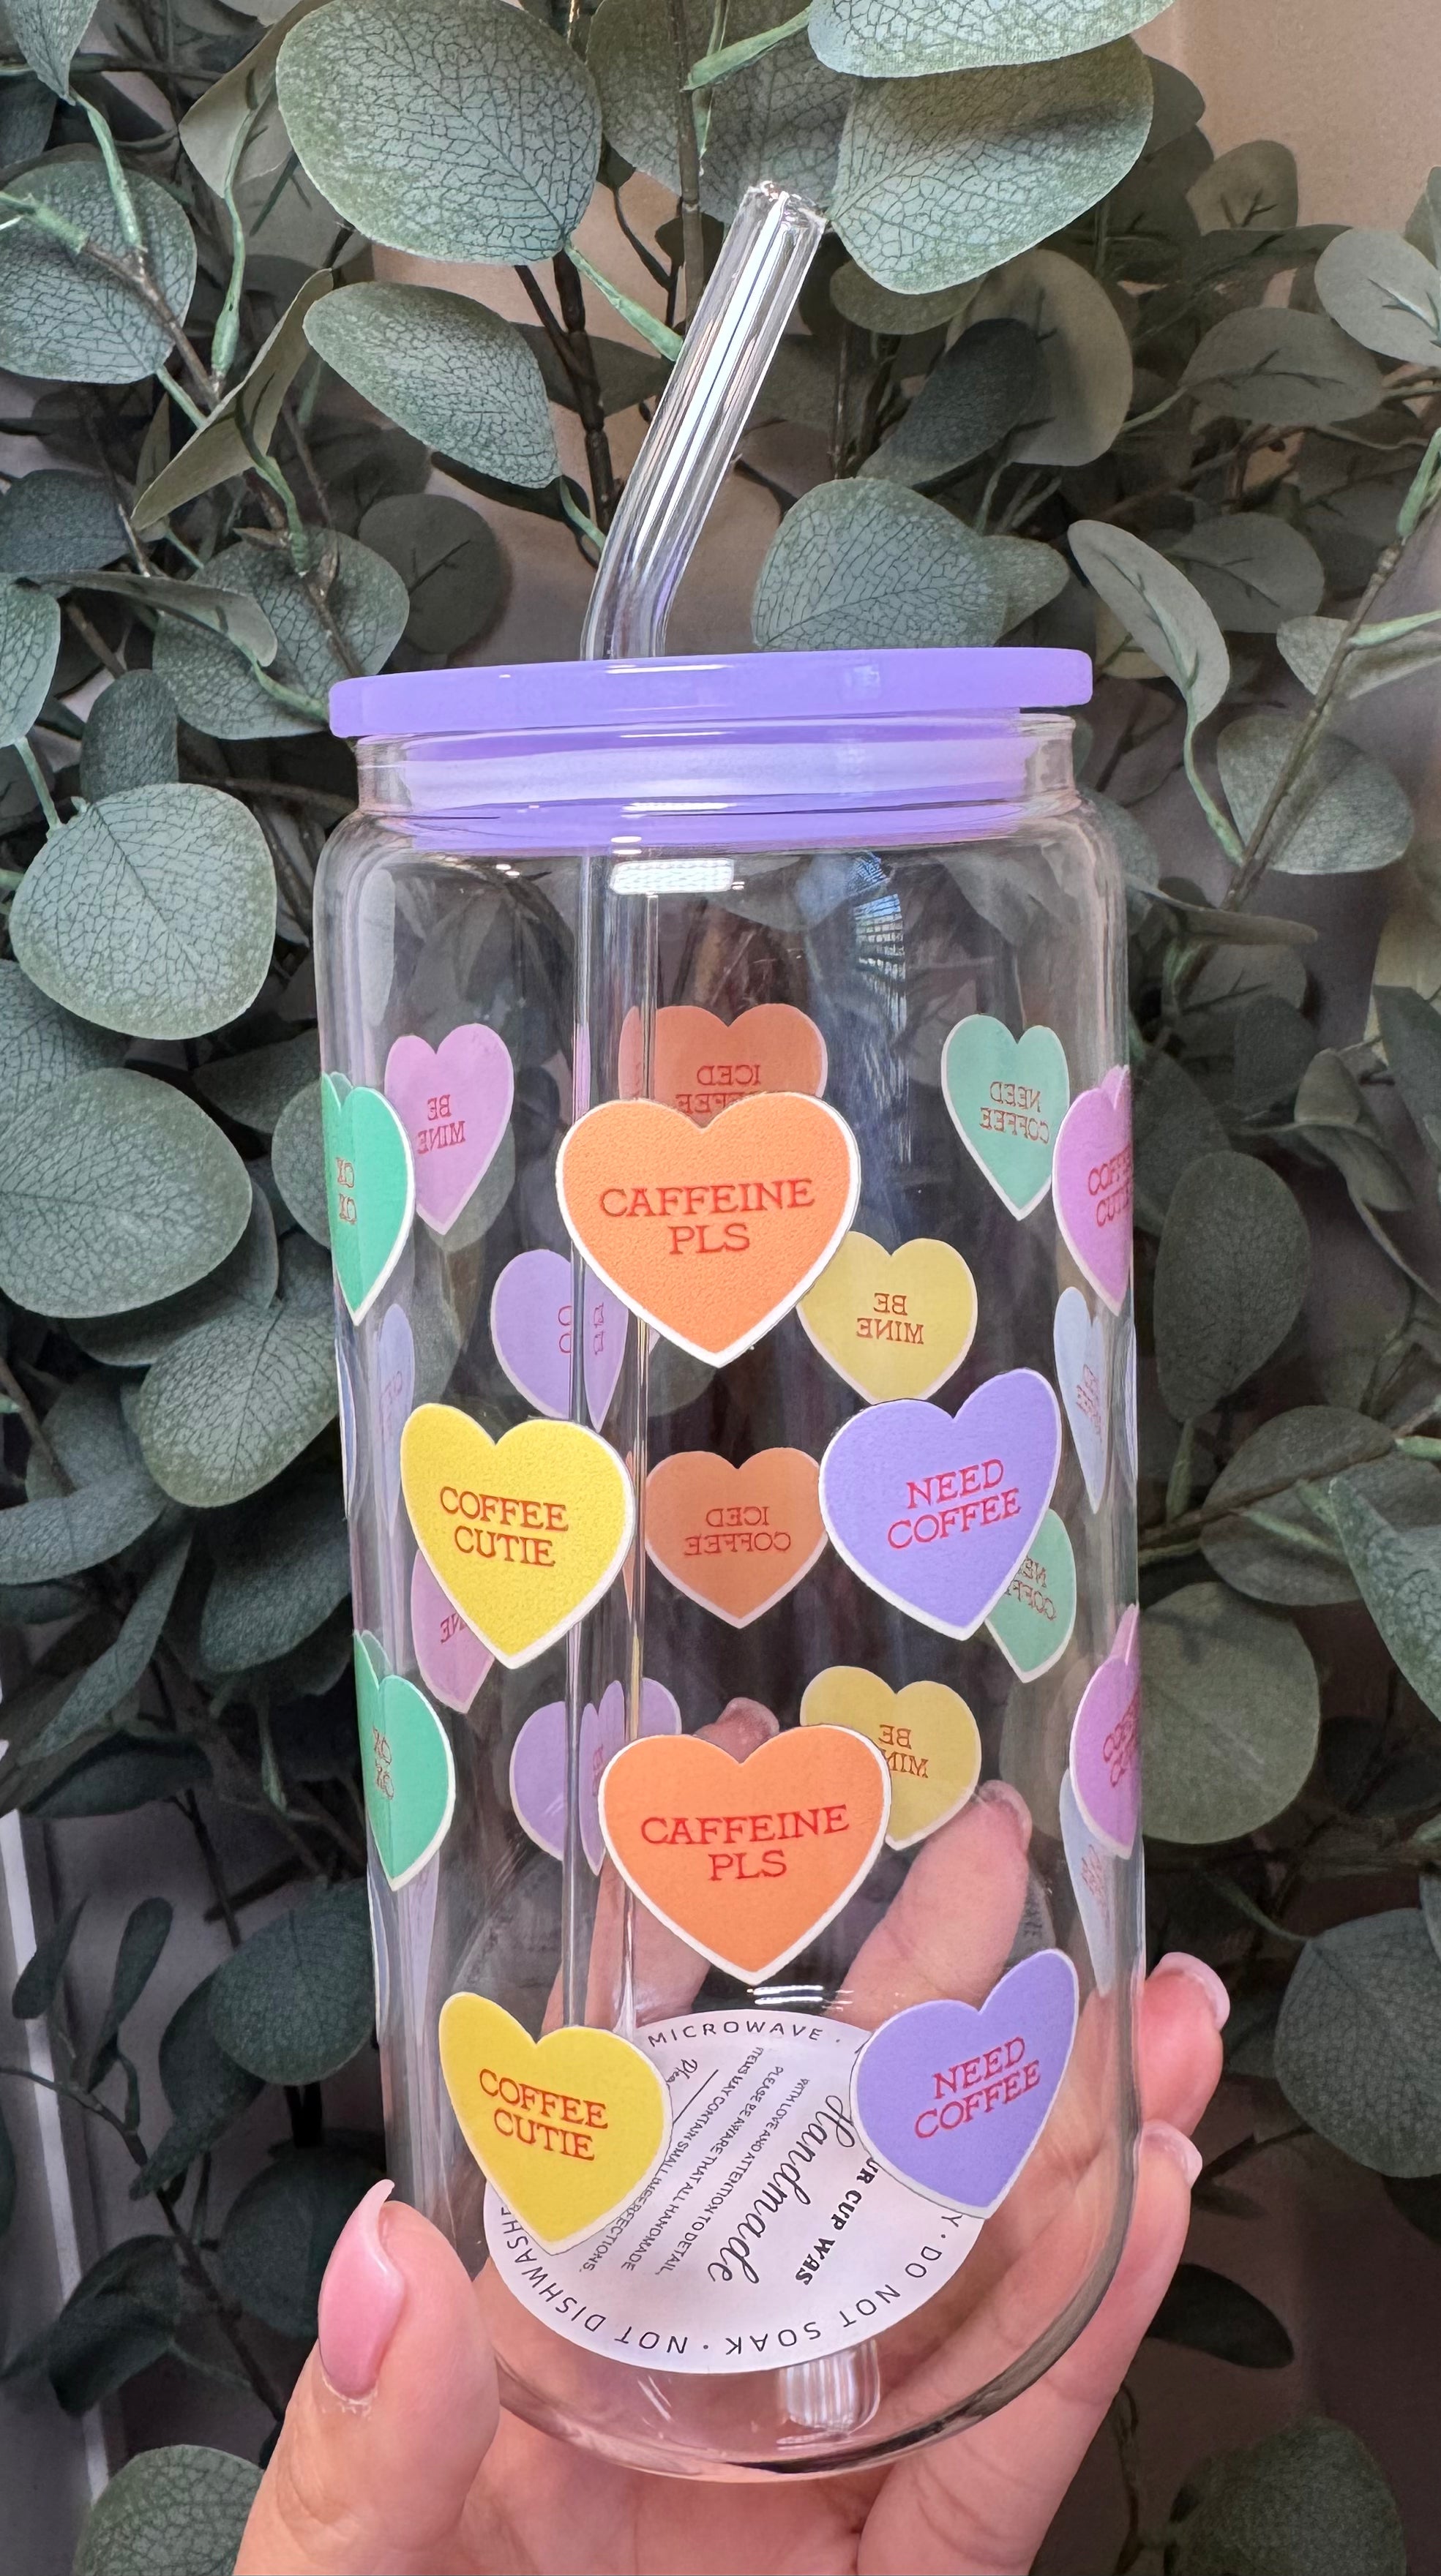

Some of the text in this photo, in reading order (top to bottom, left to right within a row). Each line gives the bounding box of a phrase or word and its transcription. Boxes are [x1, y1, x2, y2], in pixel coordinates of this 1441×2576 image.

[599, 1178, 815, 1217] CAFFEINE
[667, 1223, 750, 1255] PLS
[906, 1459, 1003, 1509] NEED
[440, 1487, 569, 1531] COFFEE
[888, 1487, 1022, 1549] COFFEE
[454, 1525, 555, 1567] CUTIE
[641, 1804, 849, 1844] CAFFEINE
[708, 1850, 787, 1881] PLS
[648, 2021, 823, 2048] MICROWAVE
[750, 2067, 784, 2103] PLEASE
[932, 2037, 1028, 2099] NEED
[479, 2069, 608, 2129] COFFEE
[739, 2103, 757, 2117] BE
[766, 2103, 791, 2130] LOVE
[915, 2059, 1041, 2138] COFFEE
[494, 2108, 594, 2160] CUTIE
[684, 2097, 725, 2141] CONTAIN
[656, 2141, 689, 2175] SMALL
[751, 2130, 771, 2152] AND
[689, 2157, 717, 2184] THAT
[704, 2152, 755, 2214] ATTENTION
[708, 2095, 855, 2284] Handmade
[673, 2182, 694, 2201] ALL
[831, 2190, 861, 2230] CUP
[621, 2204, 679, 2271] HANDMADE
[692, 2216, 711, 2231] TO
[796, 2238, 836, 2286] WAS
[905, 2246, 943, 2279] DO
[839, 2284, 901, 2328] NOT
[614, 2326, 687, 2354] NOT
[725, 2321, 821, 2355] SOAK
